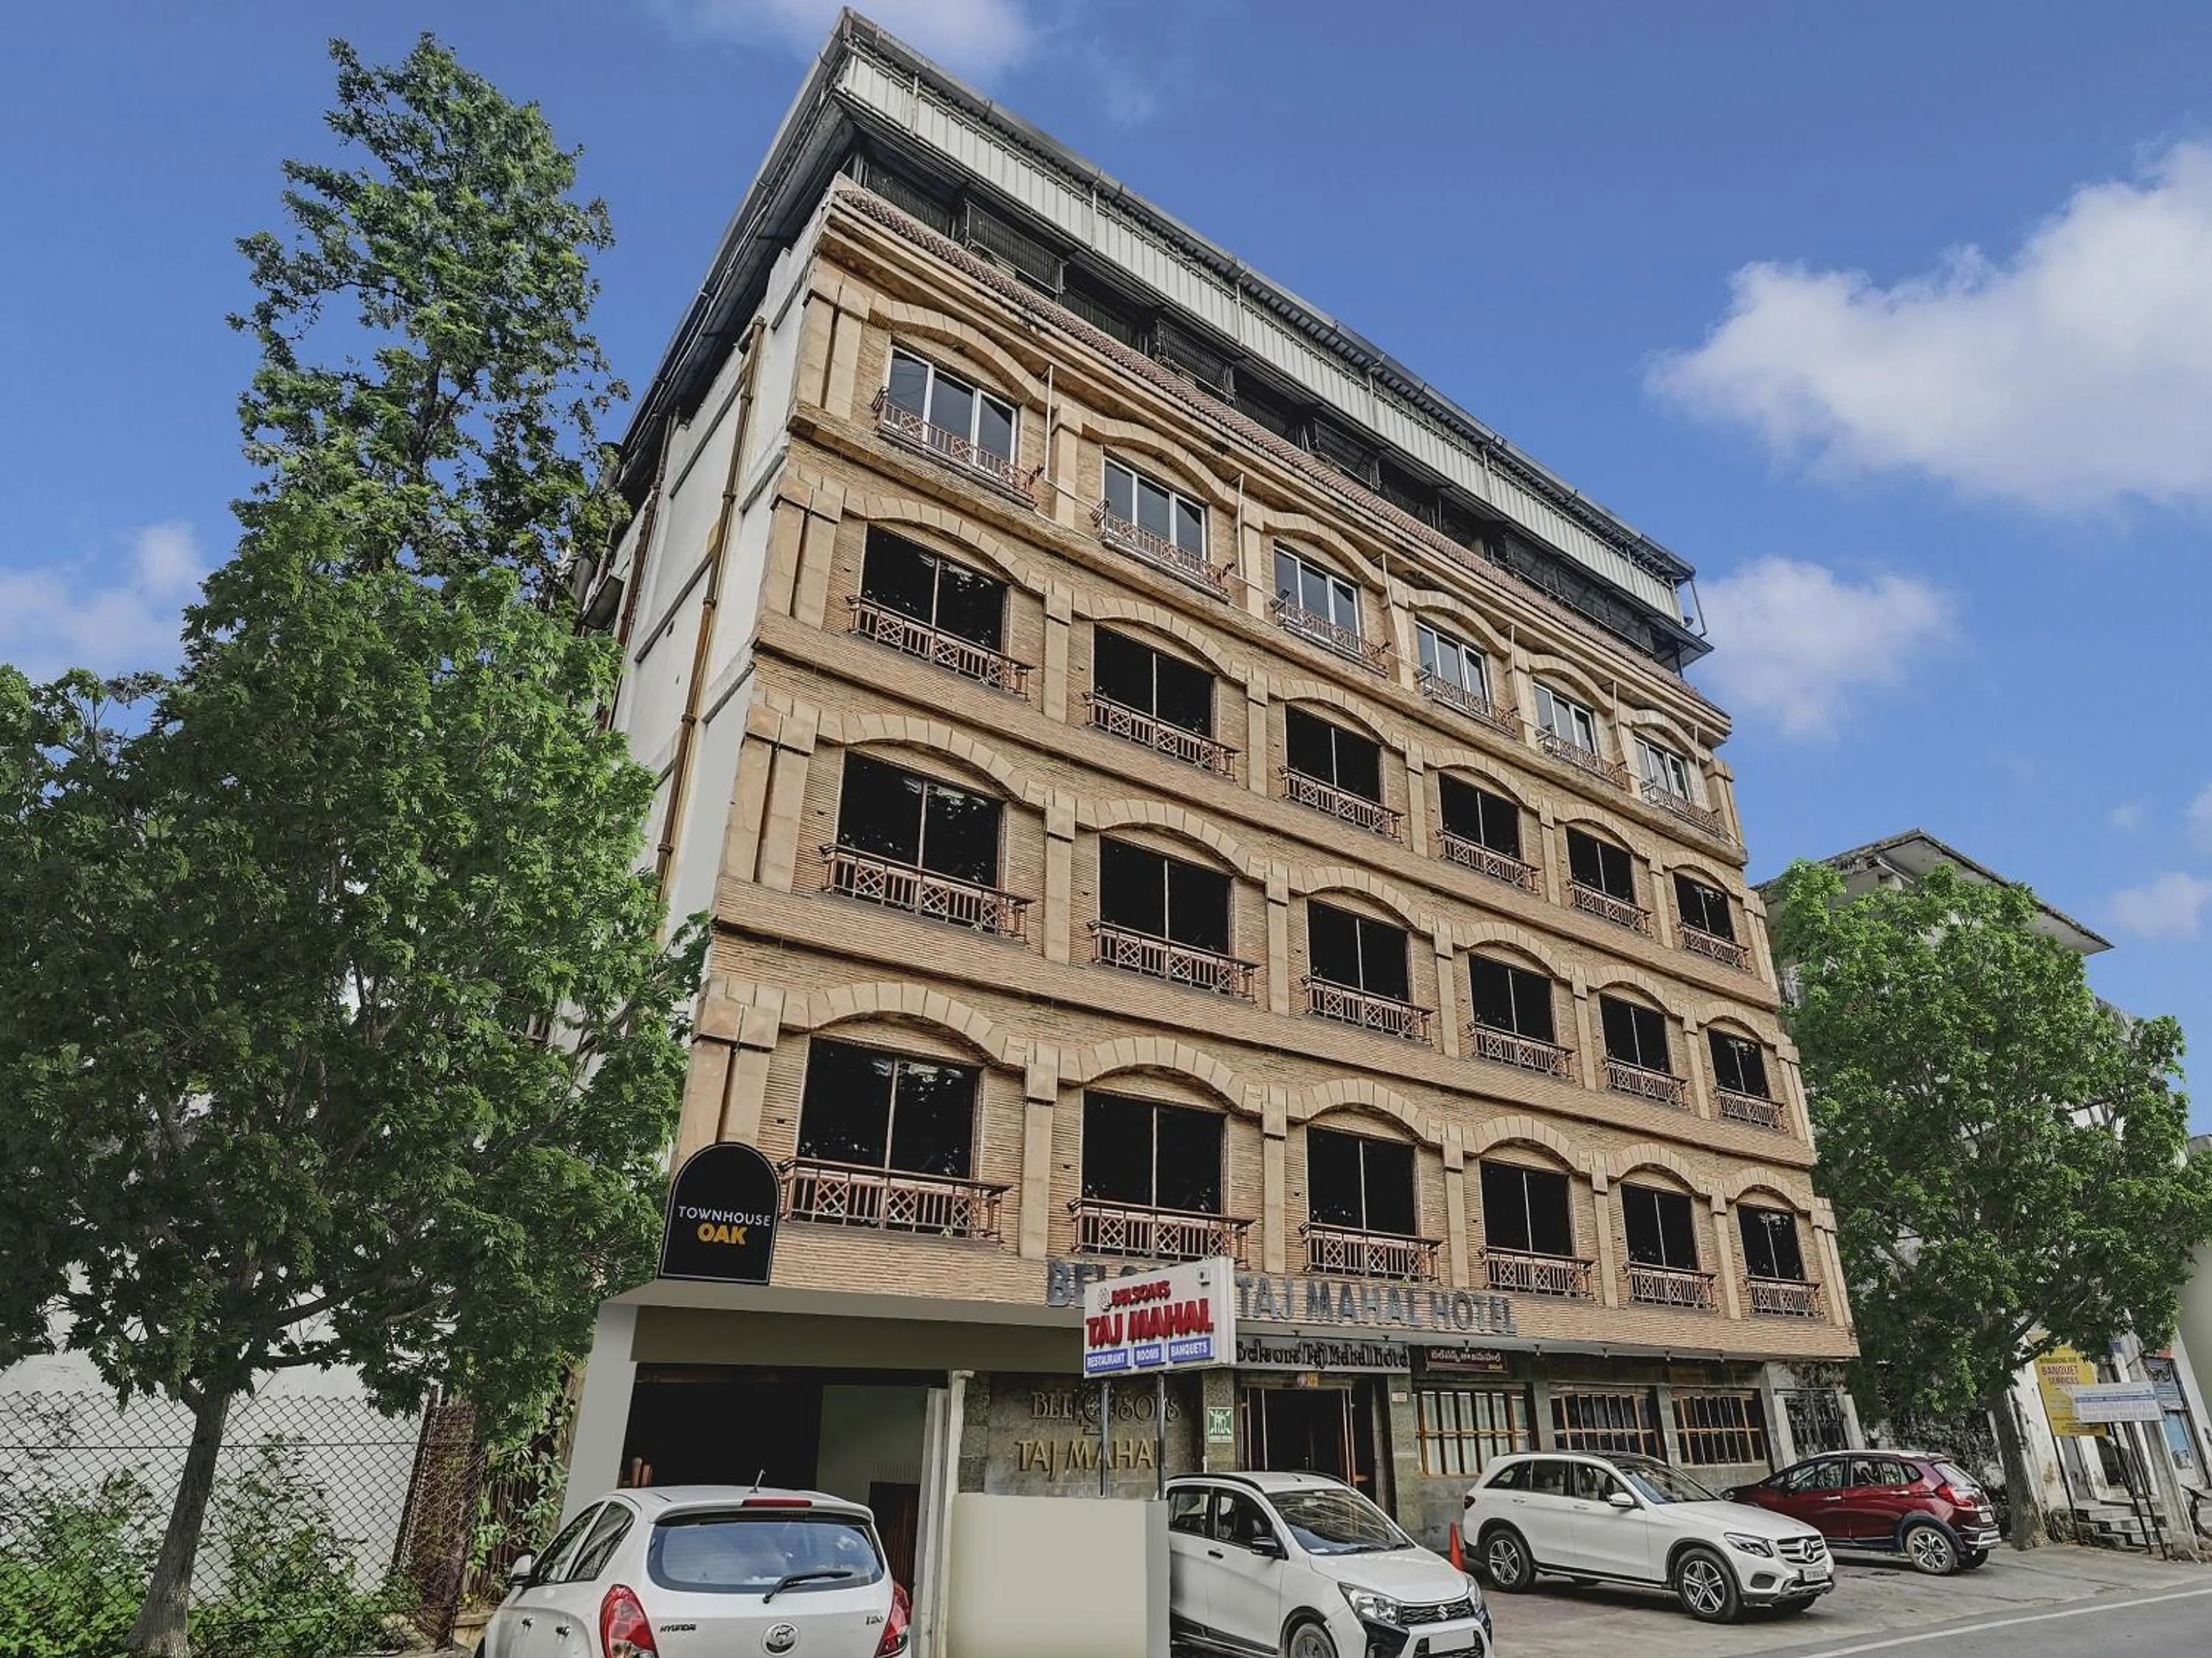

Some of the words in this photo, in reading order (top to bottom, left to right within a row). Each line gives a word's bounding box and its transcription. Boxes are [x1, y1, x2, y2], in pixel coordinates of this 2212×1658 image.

[678, 1206, 771, 1227] TOWNHOUSE
[698, 1223, 748, 1245] OAK
[1235, 1275, 1294, 1319] TAJ
[1305, 1280, 1423, 1327] MAHAL
[1430, 1291, 1518, 1336] HOTEL
[1086, 1313, 1124, 1348] TAJ
[1127, 1298, 1214, 1342] MAHAL
[1087, 1351, 1126, 1367] RESTAURANT
[1135, 1347, 1160, 1361] ROOMS
[1170, 1340, 1208, 1358] BANQUETS
[1119, 1392, 1180, 1422] SOS
[1015, 1439, 1057, 1481] TAJ
[660, 1623, 697, 1633] HYUNDAI
